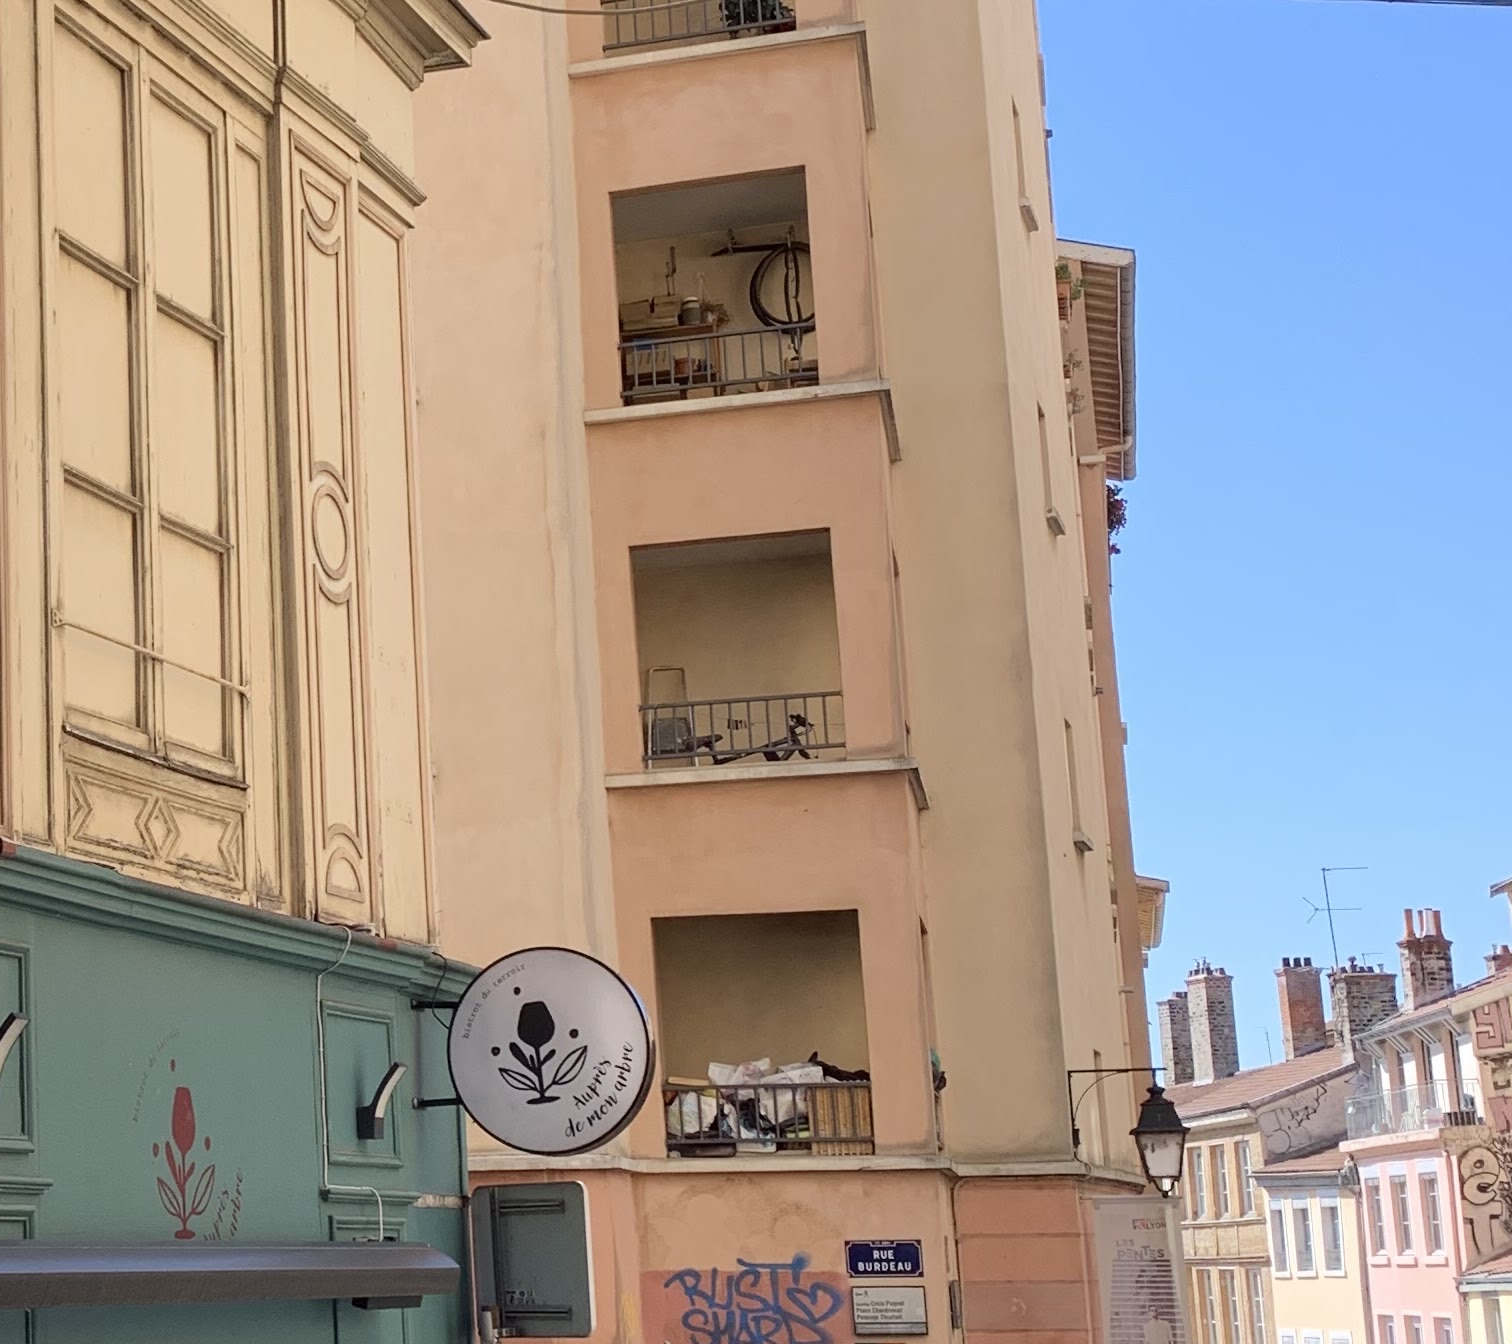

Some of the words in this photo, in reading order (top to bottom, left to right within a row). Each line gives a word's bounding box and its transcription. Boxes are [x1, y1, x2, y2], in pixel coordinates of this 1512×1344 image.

[462, 1001, 482, 1041] bistrot
[481, 987, 492, 1001] du
[492, 963, 527, 988] terroir
[564, 1116, 585, 1139] de
[586, 1091, 619, 1128] mon
[614, 1040, 635, 1091] arbre
[574, 1055, 614, 1111] Auprès
[857, 1260, 913, 1272] BURDEAU
[872, 1249, 895, 1260] RUE
[1116, 1244, 1165, 1261] PENTES
